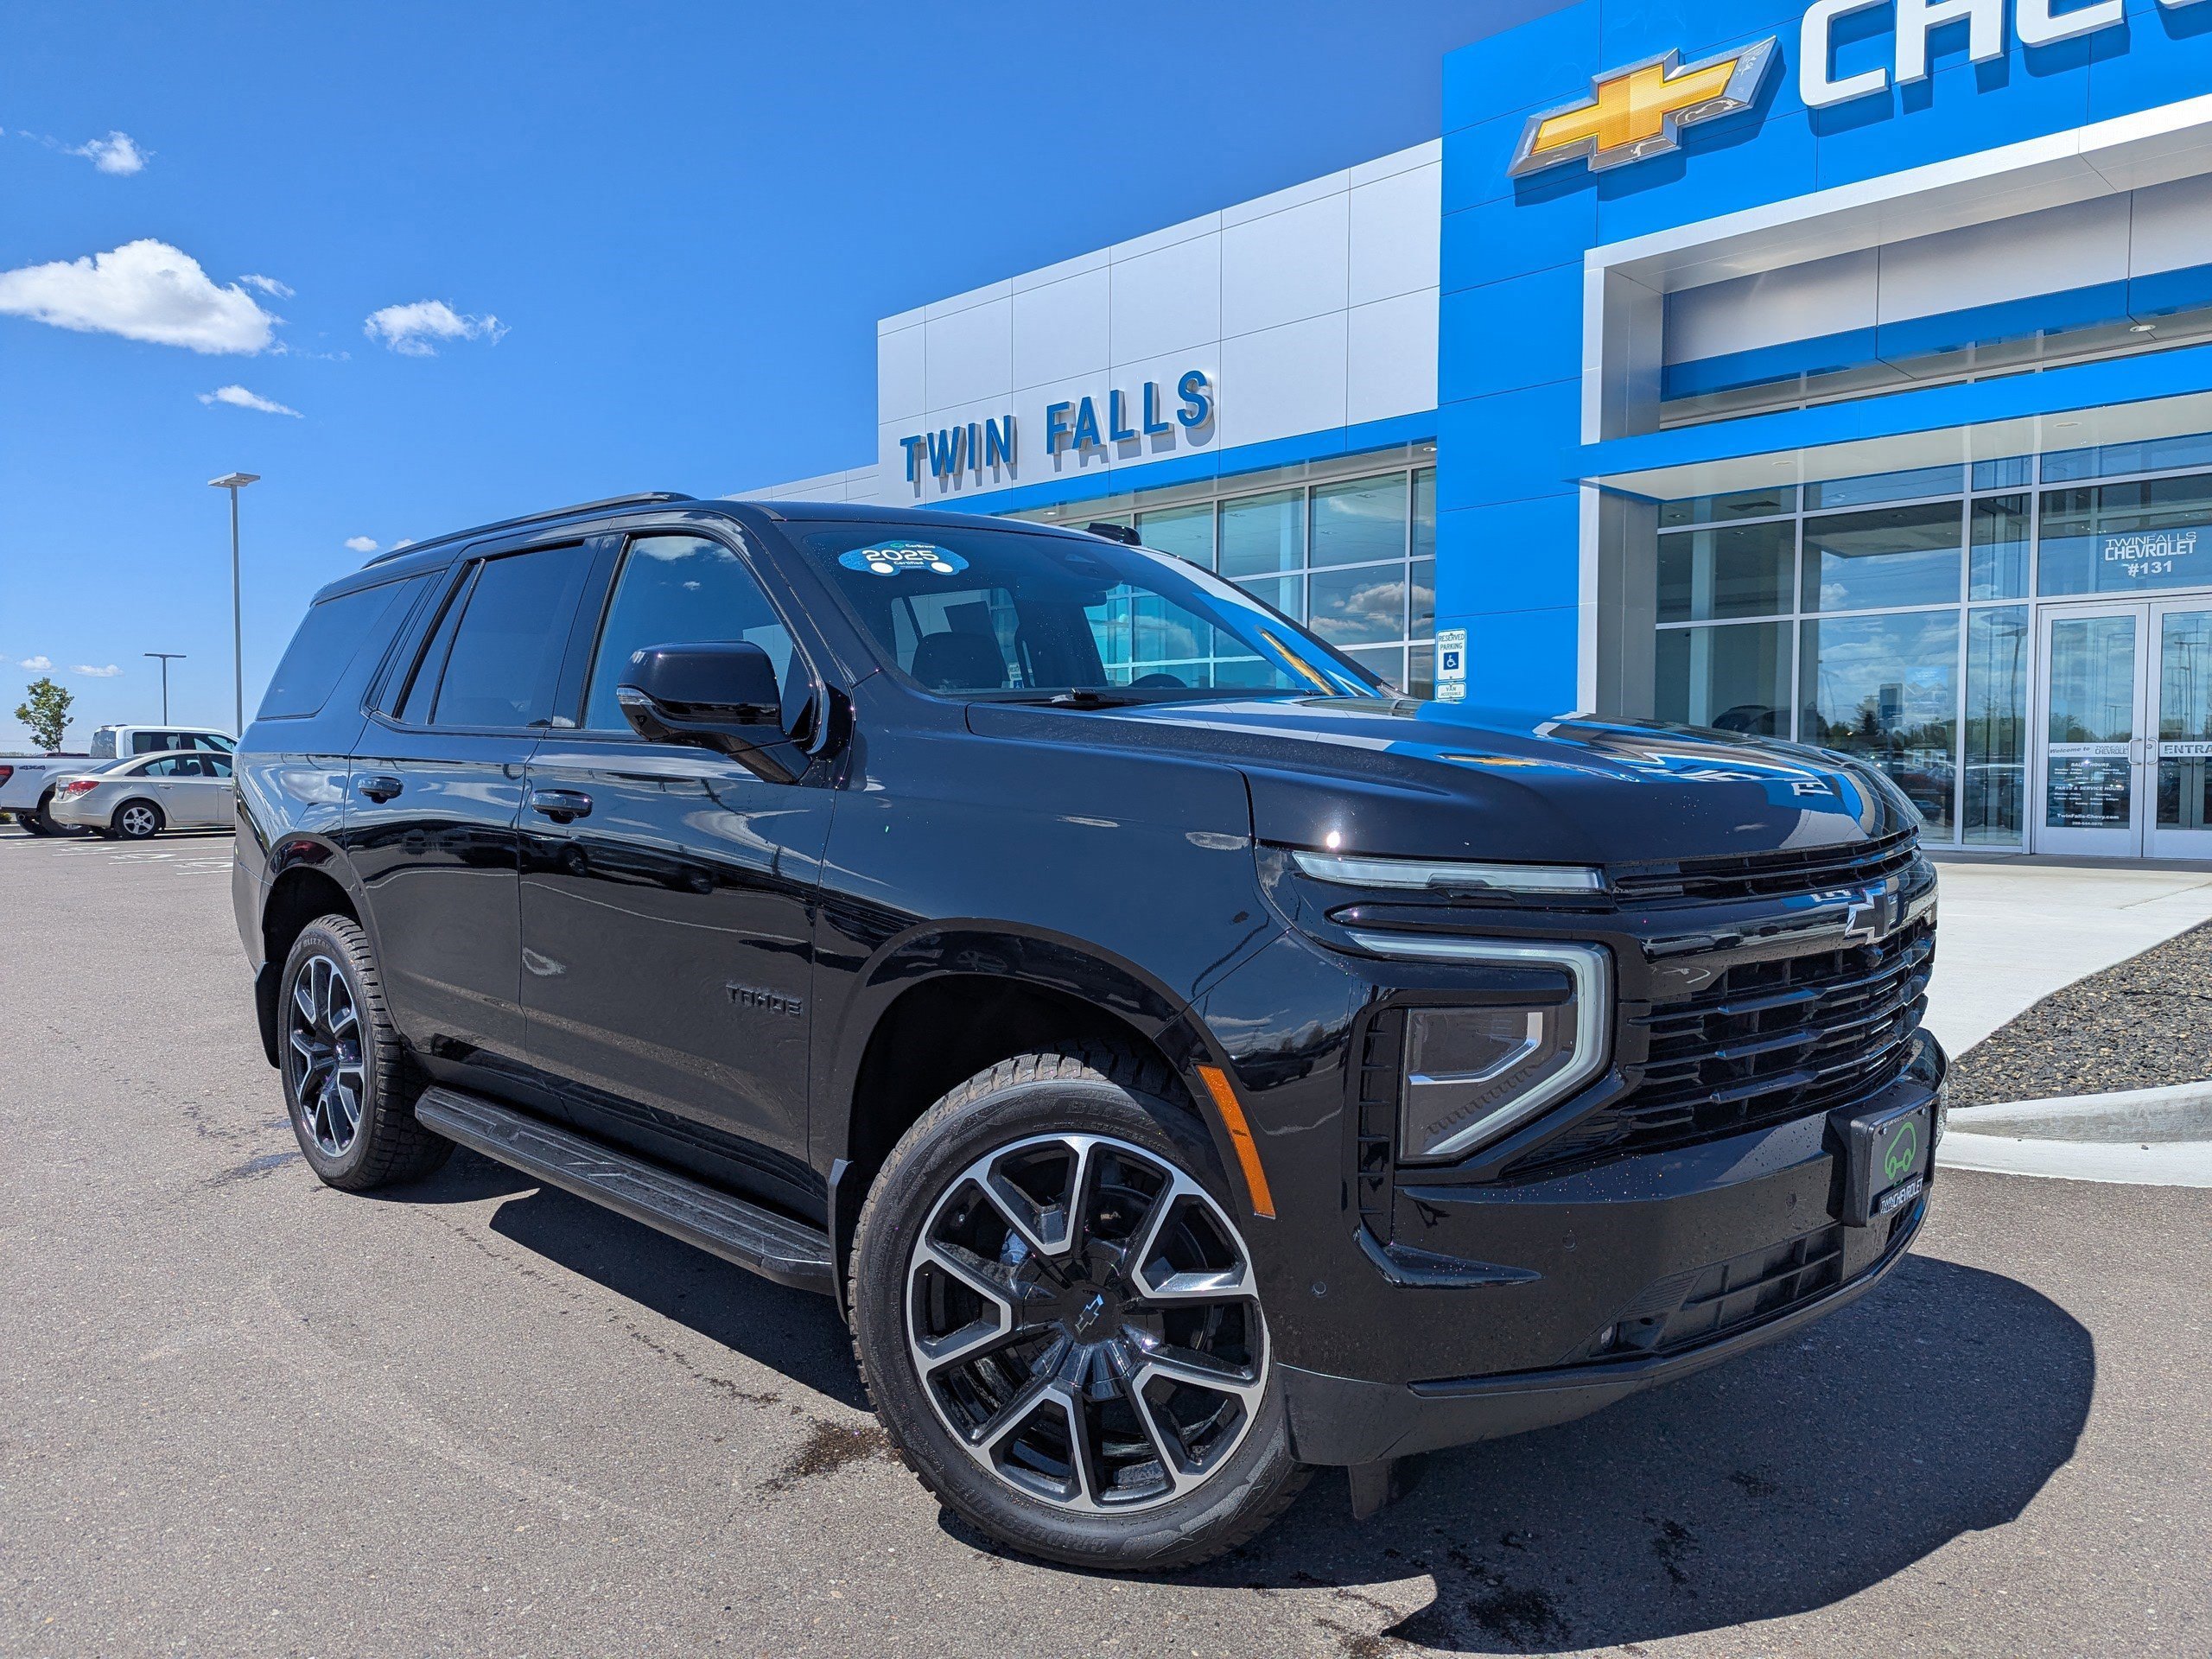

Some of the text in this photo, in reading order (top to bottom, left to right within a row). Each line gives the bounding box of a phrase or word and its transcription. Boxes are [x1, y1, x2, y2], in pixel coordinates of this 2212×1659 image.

[899, 370, 1215, 483] TWIN FALLS
[861, 549, 939, 562] 2025
[2105, 540, 2196, 561] CHEVROLET
[2127, 561, 2172, 576] #131
[1439, 633, 1465, 642] RESERVED
[1440, 642, 1463, 651] PARKING
[1892, 1178, 1923, 1208] CHEVROLET
